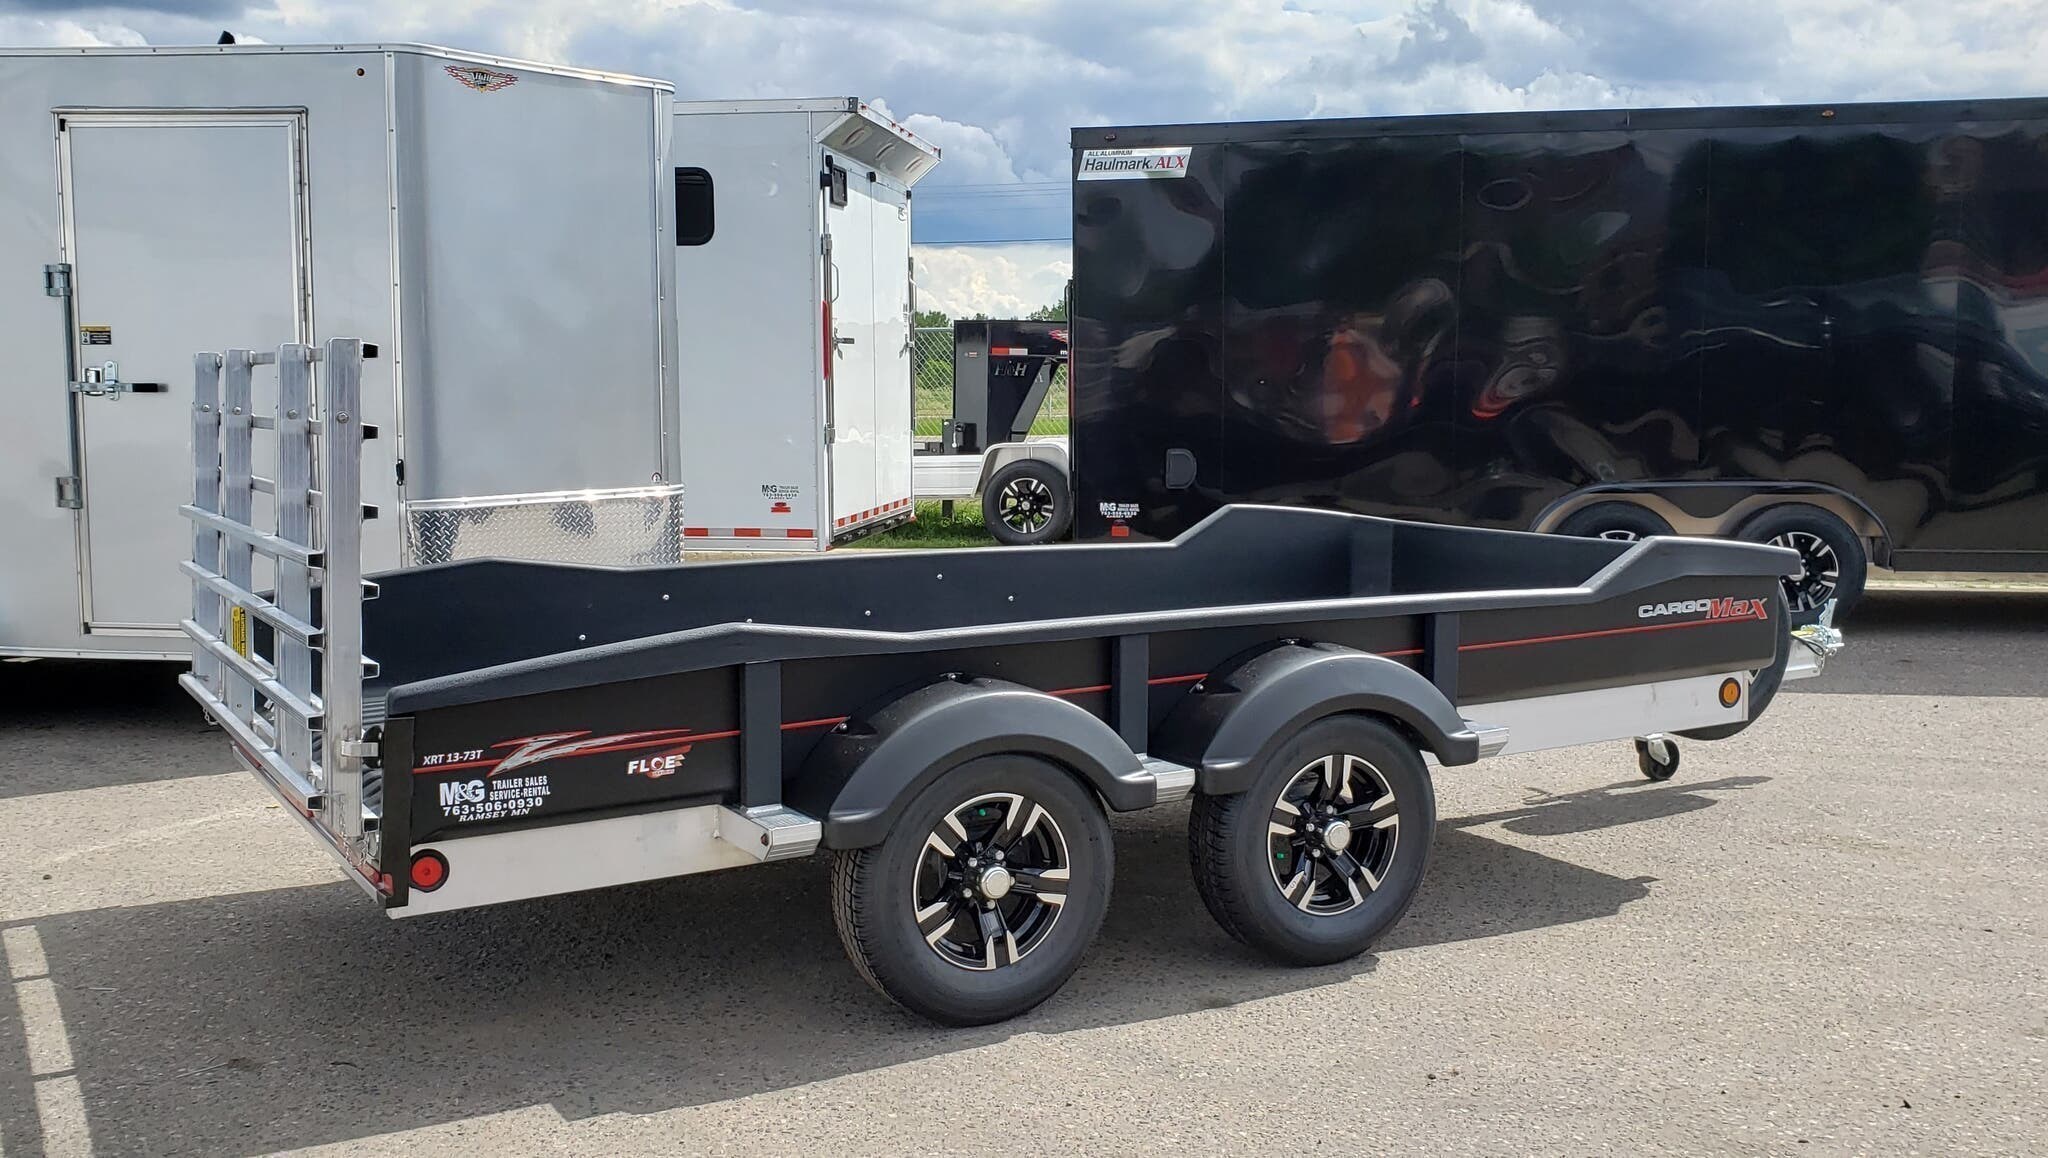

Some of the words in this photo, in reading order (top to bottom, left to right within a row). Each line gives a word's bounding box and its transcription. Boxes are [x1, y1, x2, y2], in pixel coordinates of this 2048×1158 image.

[1154, 155, 1186, 169] ALX
[422, 754, 445, 766] XRT
[446, 749, 484, 763] 13-73T
[627, 754, 686, 775] FLOE
[492, 778, 523, 791] TRAILER
[524, 775, 548, 787] SALES
[439, 779, 486, 807] M&G
[458, 809, 508, 823] RAMSEY
[510, 807, 531, 817] MN
